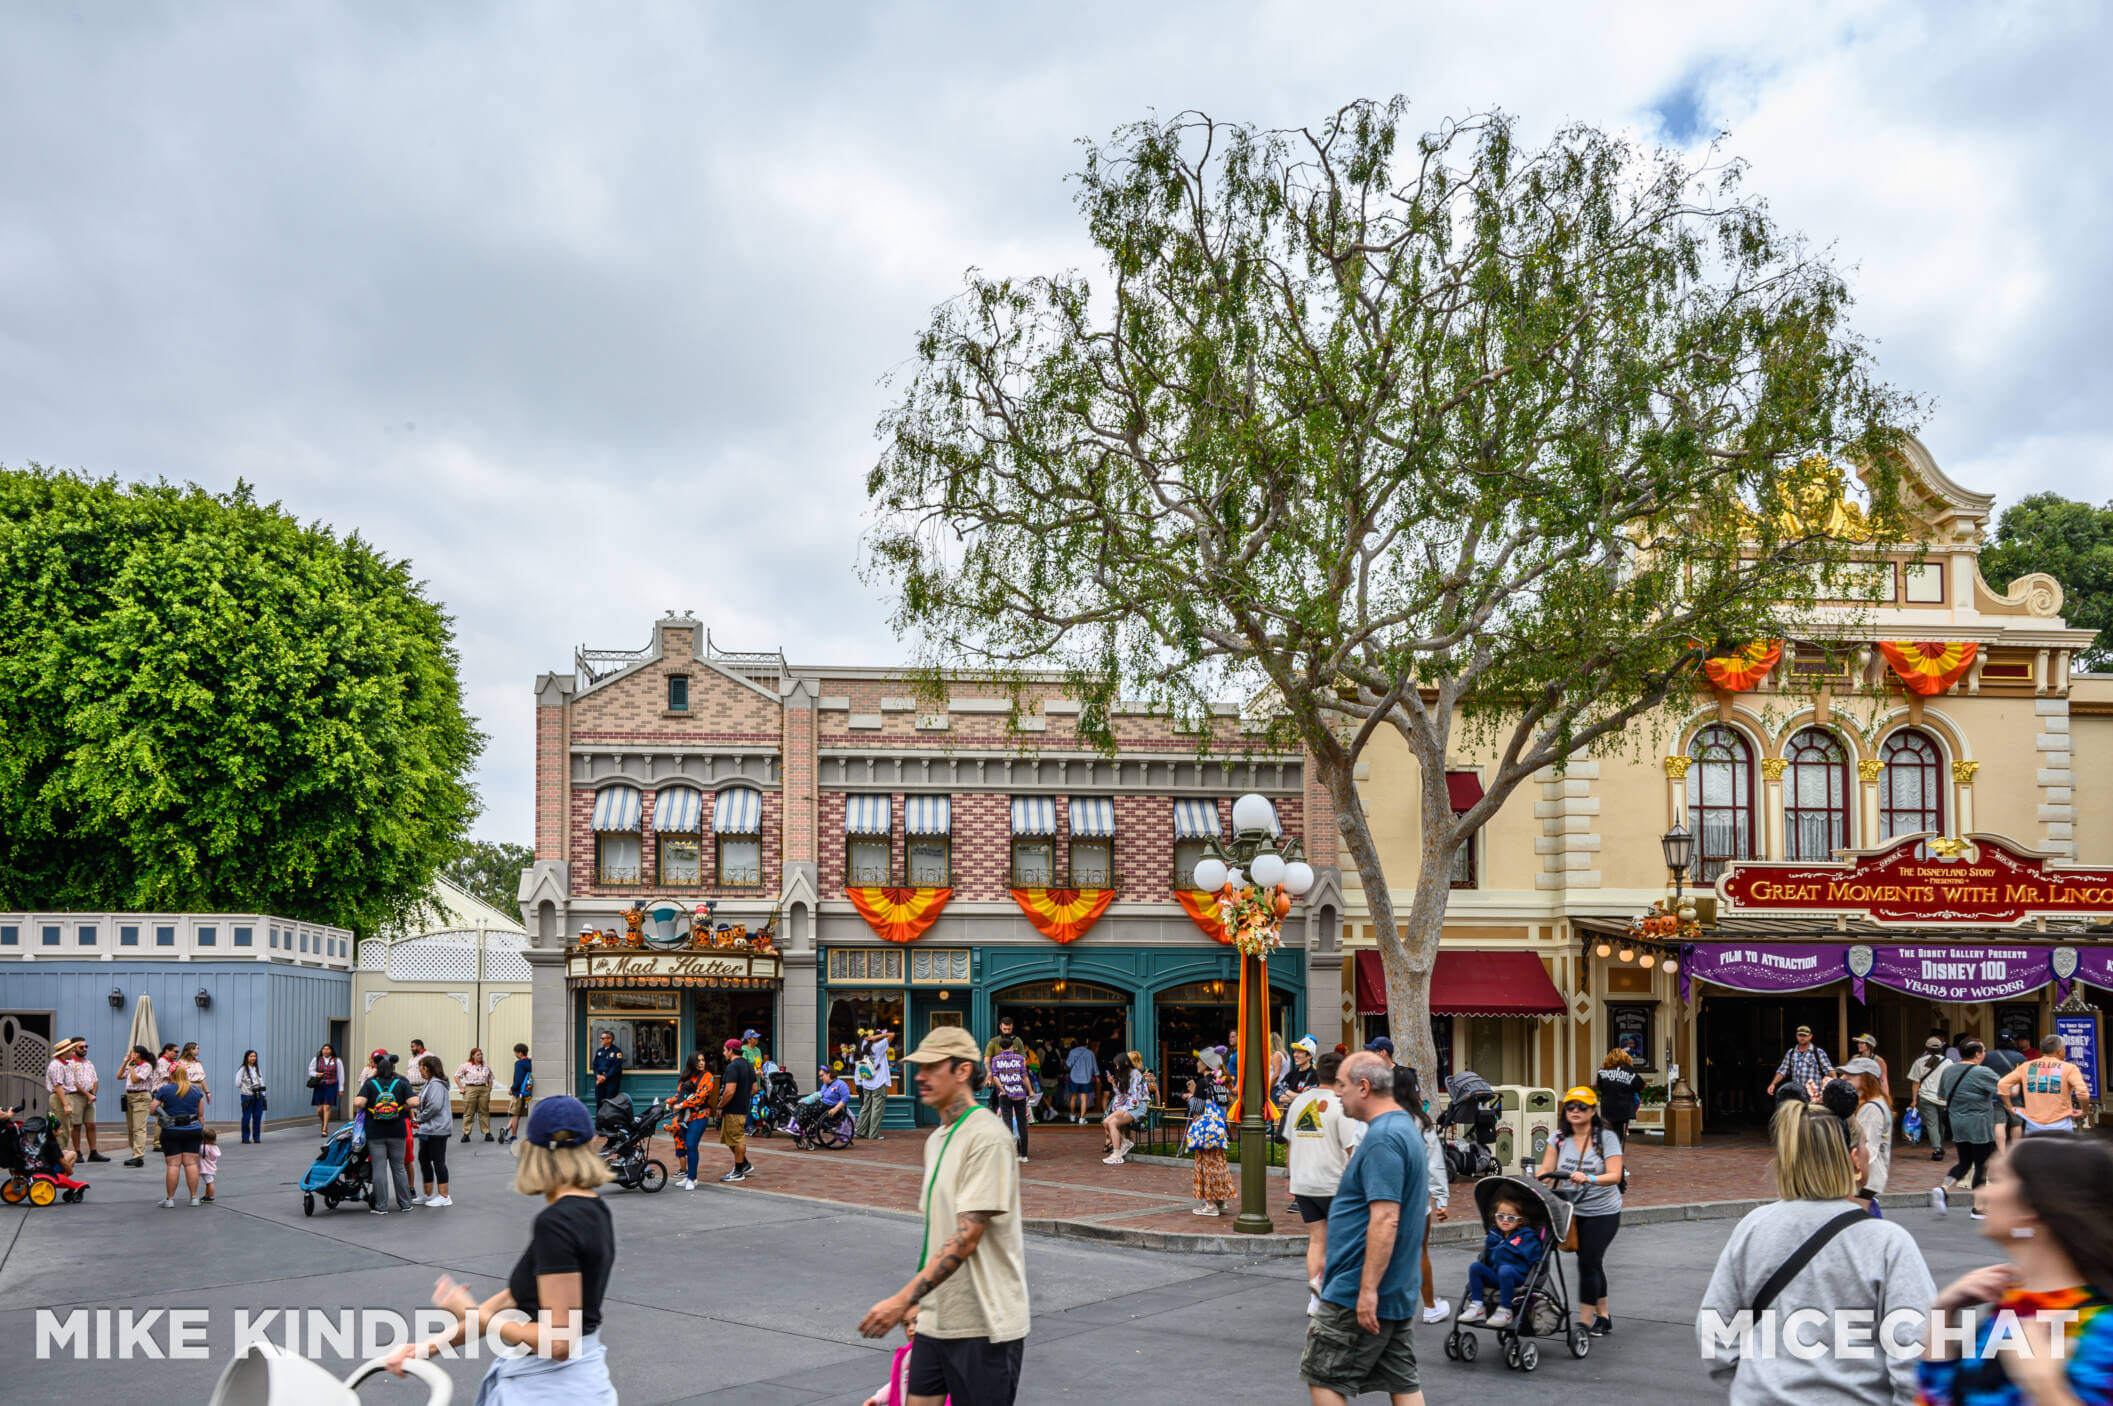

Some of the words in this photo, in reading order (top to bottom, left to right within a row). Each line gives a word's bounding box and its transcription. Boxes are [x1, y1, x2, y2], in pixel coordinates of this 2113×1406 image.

[1898, 866, 1914, 876] THE
[1917, 867, 1967, 877] DISNEYLAND
[1969, 867, 1996, 877] STORY
[1750, 881, 1821, 901] GREAT
[1828, 882, 1934, 902] MOMENTS
[1942, 886, 1998, 903] WITH
[2004, 884, 2045, 903] MR.
[1720, 950, 1742, 965] FILM
[1745, 950, 1758, 963] TO
[1761, 952, 1818, 970] ATTRACTION
[1899, 948, 1915, 958] THE
[1918, 948, 1946, 959] DISNEY
[1950, 948, 1984, 959] GALLERY
[1988, 949, 2028, 960] PRESENTS
[606, 955, 659, 975] Mad
[668, 955, 744, 975] Hatter
[1921, 960, 1976, 980] DISNEY
[1979, 960, 2007, 980] 100
[1904, 978, 1948, 998] YEARS
[1950, 986, 1968, 998] OF
[1970, 979, 2025, 998] WONDER
[2062, 1033, 2089, 1046] DISNEY
[2070, 1046, 2083, 1058] 100
